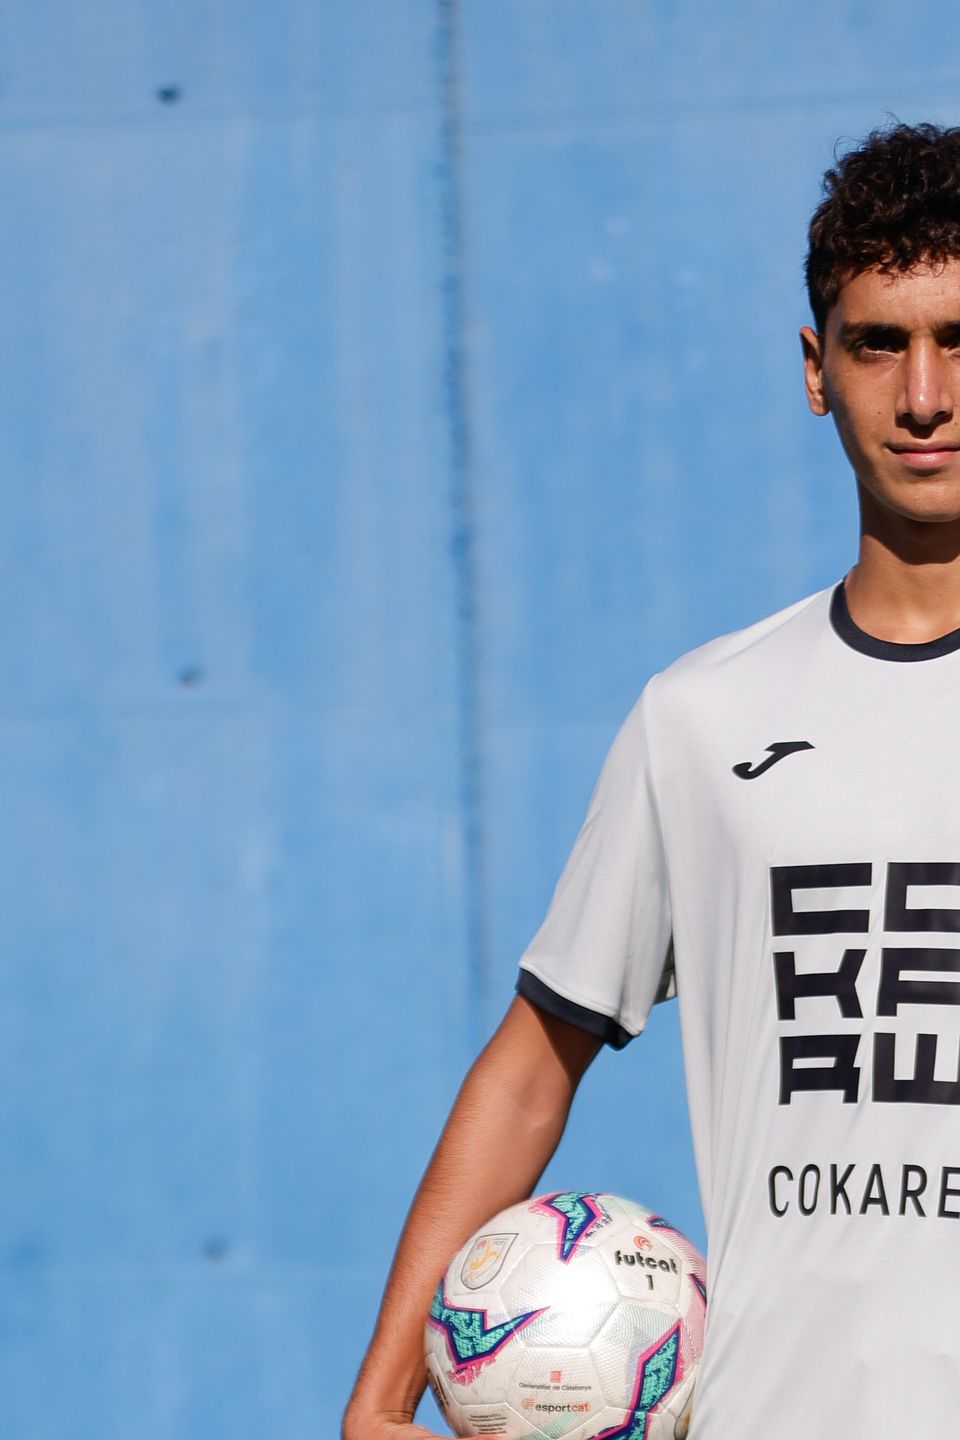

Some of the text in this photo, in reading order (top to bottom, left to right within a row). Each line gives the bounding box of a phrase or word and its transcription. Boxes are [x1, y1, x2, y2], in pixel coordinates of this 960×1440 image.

[614, 1249, 678, 1275] futcat
[645, 1274, 654, 1291] 1
[535, 1402, 590, 1413] esportcat
